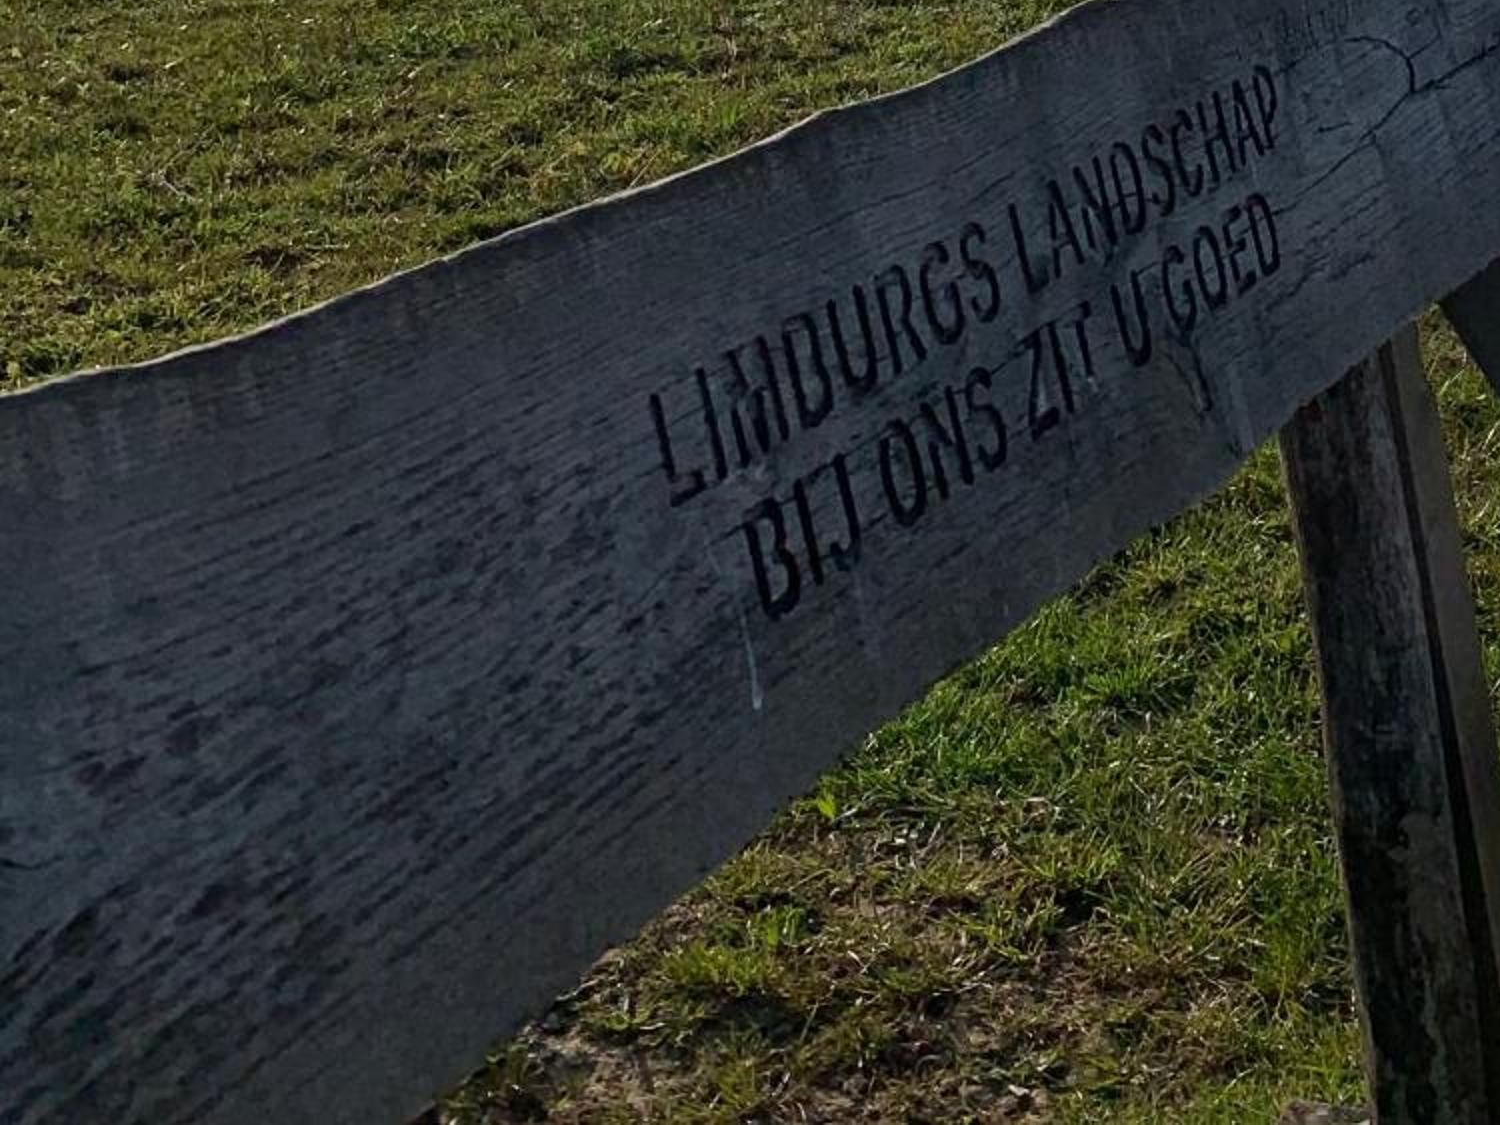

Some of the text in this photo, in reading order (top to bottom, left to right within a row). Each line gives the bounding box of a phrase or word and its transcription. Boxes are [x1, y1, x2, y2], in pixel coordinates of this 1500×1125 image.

[648, 64, 1277, 508] LIMBURGS LANDSCHAP
[742, 192, 1281, 621] BIJ ONS ZIT U GOED
